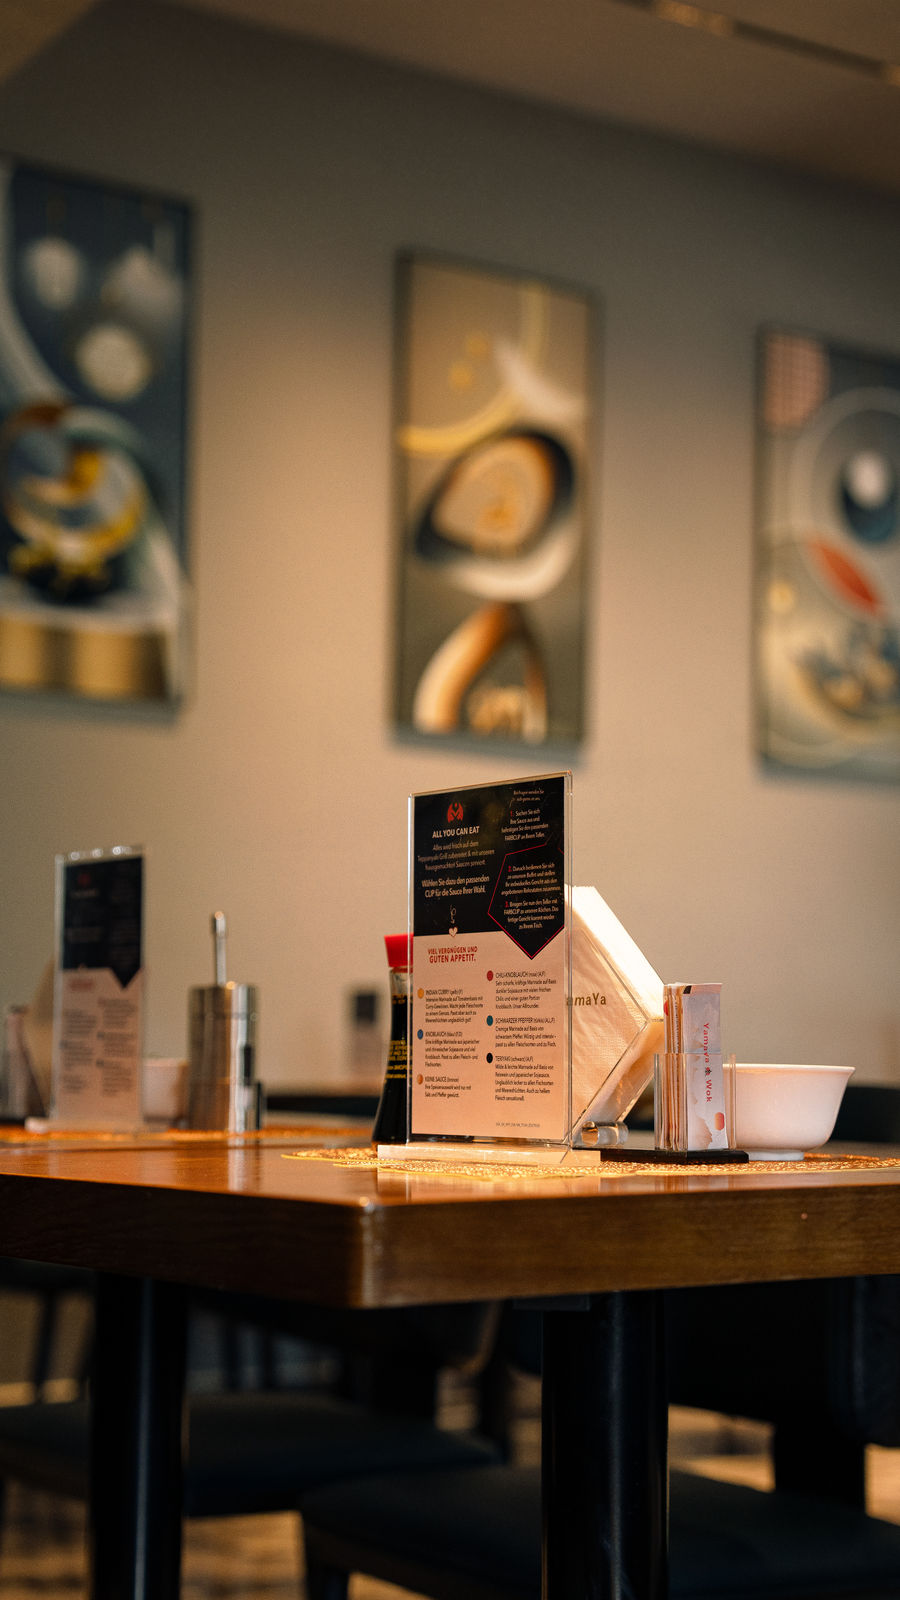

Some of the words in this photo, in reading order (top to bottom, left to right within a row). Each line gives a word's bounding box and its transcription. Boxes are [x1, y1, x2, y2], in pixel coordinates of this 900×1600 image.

[432, 830, 442, 838] ALL
[443, 829, 455, 837] YOU
[456, 828, 468, 836] CAN
[469, 826, 480, 834] EAT
[450, 888, 462, 896] Sauce
[438, 946, 466, 954] VERGNÜGEN
[430, 956, 448, 964] GUTEN
[450, 954, 476, 962] APPETIT.
[565, 992, 606, 1006] amaYa
